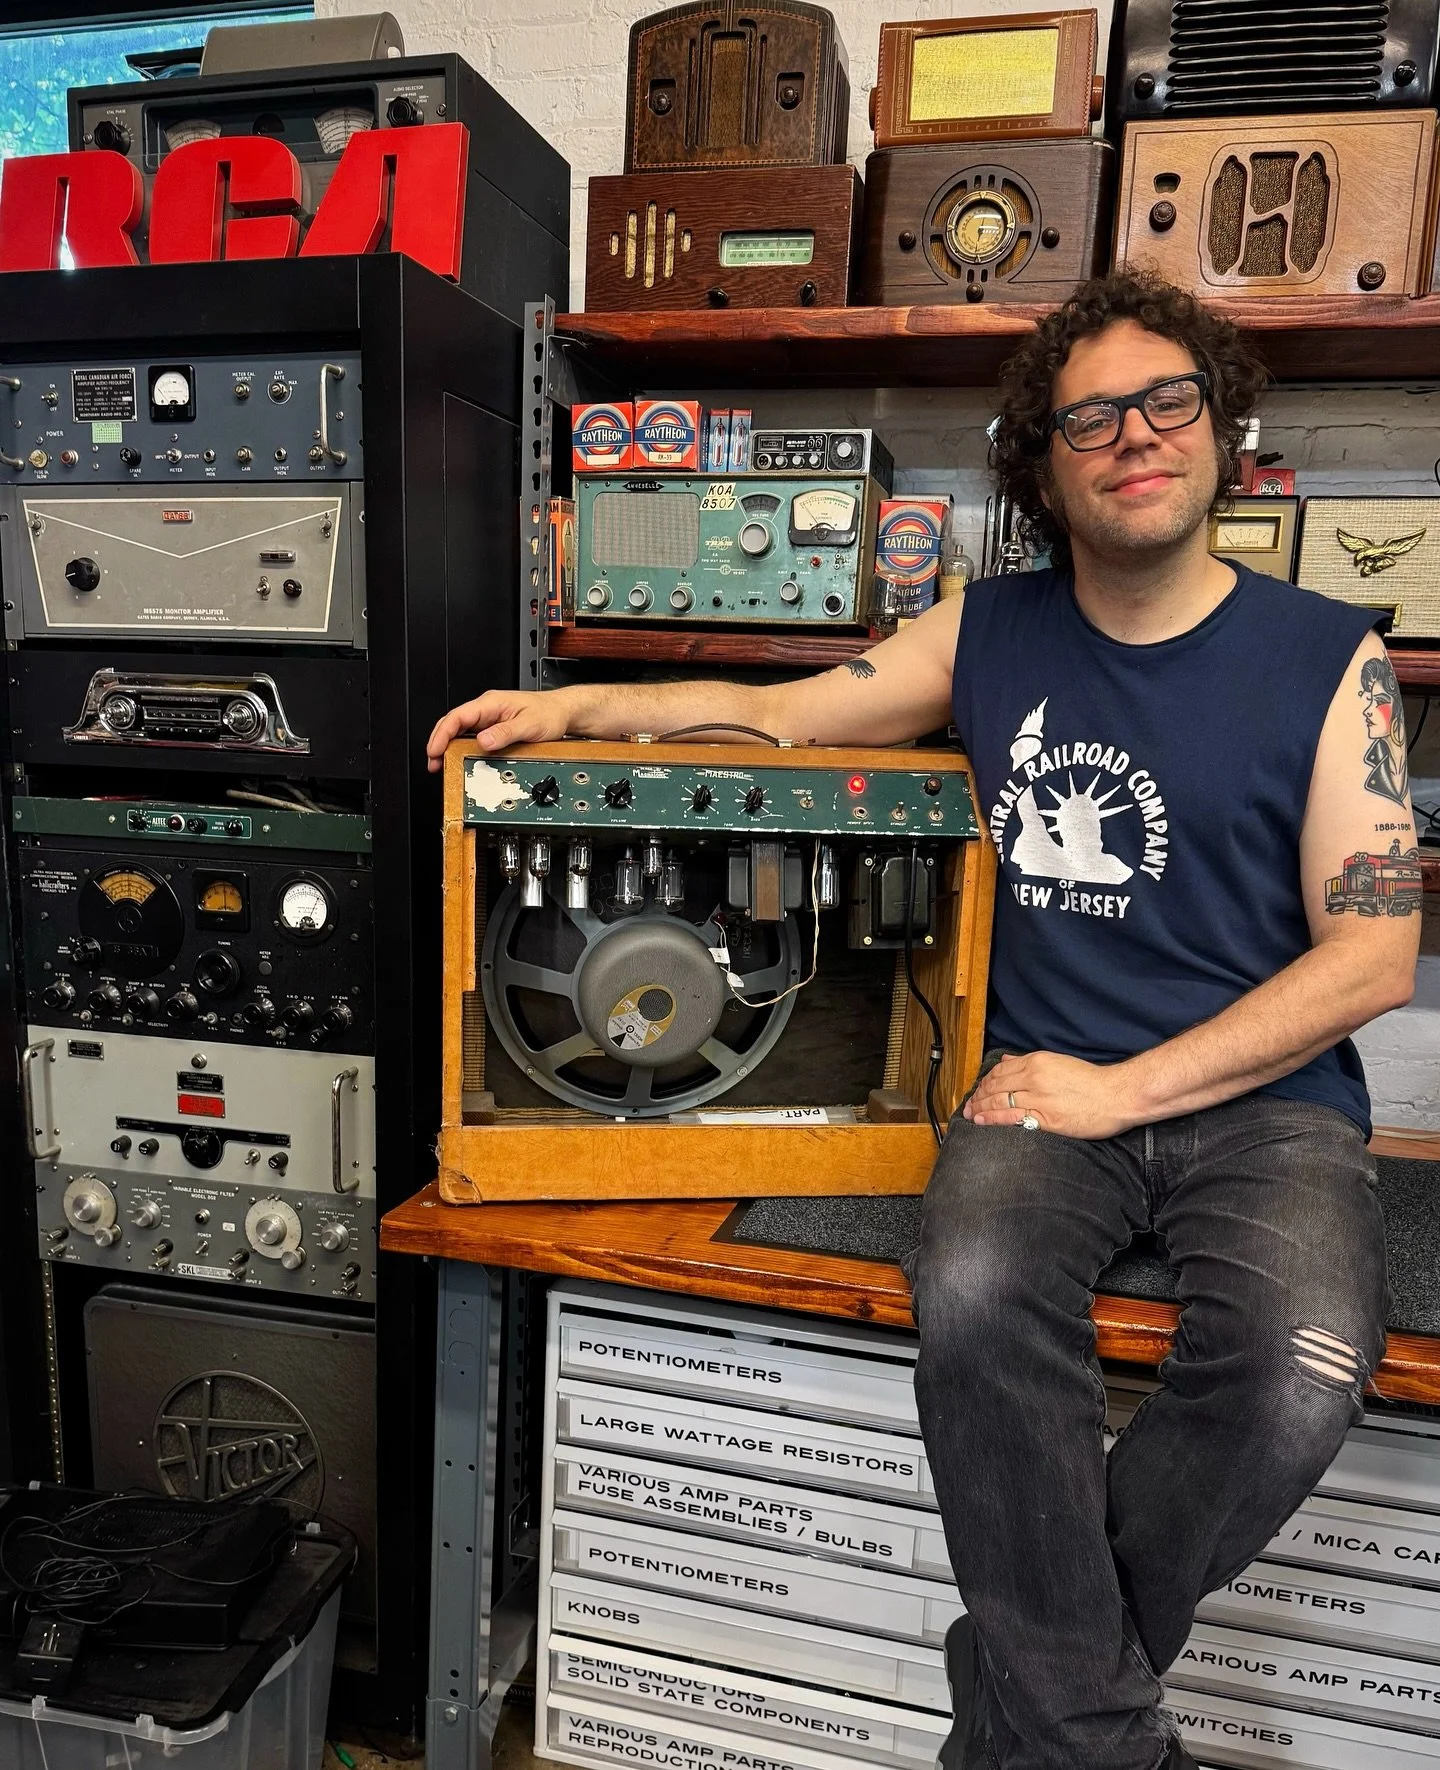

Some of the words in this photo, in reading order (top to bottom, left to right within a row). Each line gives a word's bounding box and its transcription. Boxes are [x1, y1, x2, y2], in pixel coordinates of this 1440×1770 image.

[0, 122, 469, 284] RCA
[581, 428, 623, 443] RAYTHEON
[644, 426, 687, 440] RAYTHEON
[708, 484, 732, 496] KOA
[1261, 484, 1282, 493] RCA
[701, 497, 736, 509] 8507
[884, 535, 932, 550] RAYTHEON
[704, 769, 745, 779] MAESTRO
[152, 817, 166, 825] ALTEC
[1023, 741, 1130, 782] RAILROAD
[1127, 769, 1169, 881] COMPANY
[1058, 879, 1076, 890] OF
[1059, 890, 1131, 919] JERSEY
[780, 1108, 821, 1118] PART:
[173, 1185, 192, 1193] VARIABLE
[192, 1188, 219, 1196] ELECTRONIC
[219, 1190, 235, 1198] FILTER
[181, 1265, 196, 1275] SKL
[578, 1340, 783, 1385] POTENTIOMETERS
[580, 1413, 655, 1436] LARGE
[664, 1426, 774, 1454] WATTAGE
[782, 1443, 915, 1476] RESISTORS
[174, 1422, 304, 1502] VICTOR
[578, 1464, 671, 1494] VARIOUS
[680, 1486, 729, 1503] AMP
[738, 1496, 814, 1522] PARTS
[578, 1480, 634, 1502] FUSE
[643, 1495, 788, 1534] ASSEMBLIES
[814, 1531, 894, 1557] BULBS
[1313, 1532, 1382, 1555] MICA
[588, 1547, 790, 1596] POTENTIOMETERS
[1227, 1580, 1366, 1615] IOMETERS
[567, 1601, 641, 1625] KNOBS
[1180, 1648, 1278, 1676] ARIOUS
[1288, 1668, 1349, 1687] AMP
[567, 1667, 630, 1688] SOLID
[638, 1682, 705, 1706] STATE
[714, 1698, 871, 1741] COMPONENTS
[569, 1716, 658, 1746] VARIOUS
[666, 1739, 714, 1758] AMP
[1176, 1711, 1294, 1746] WITCHES
